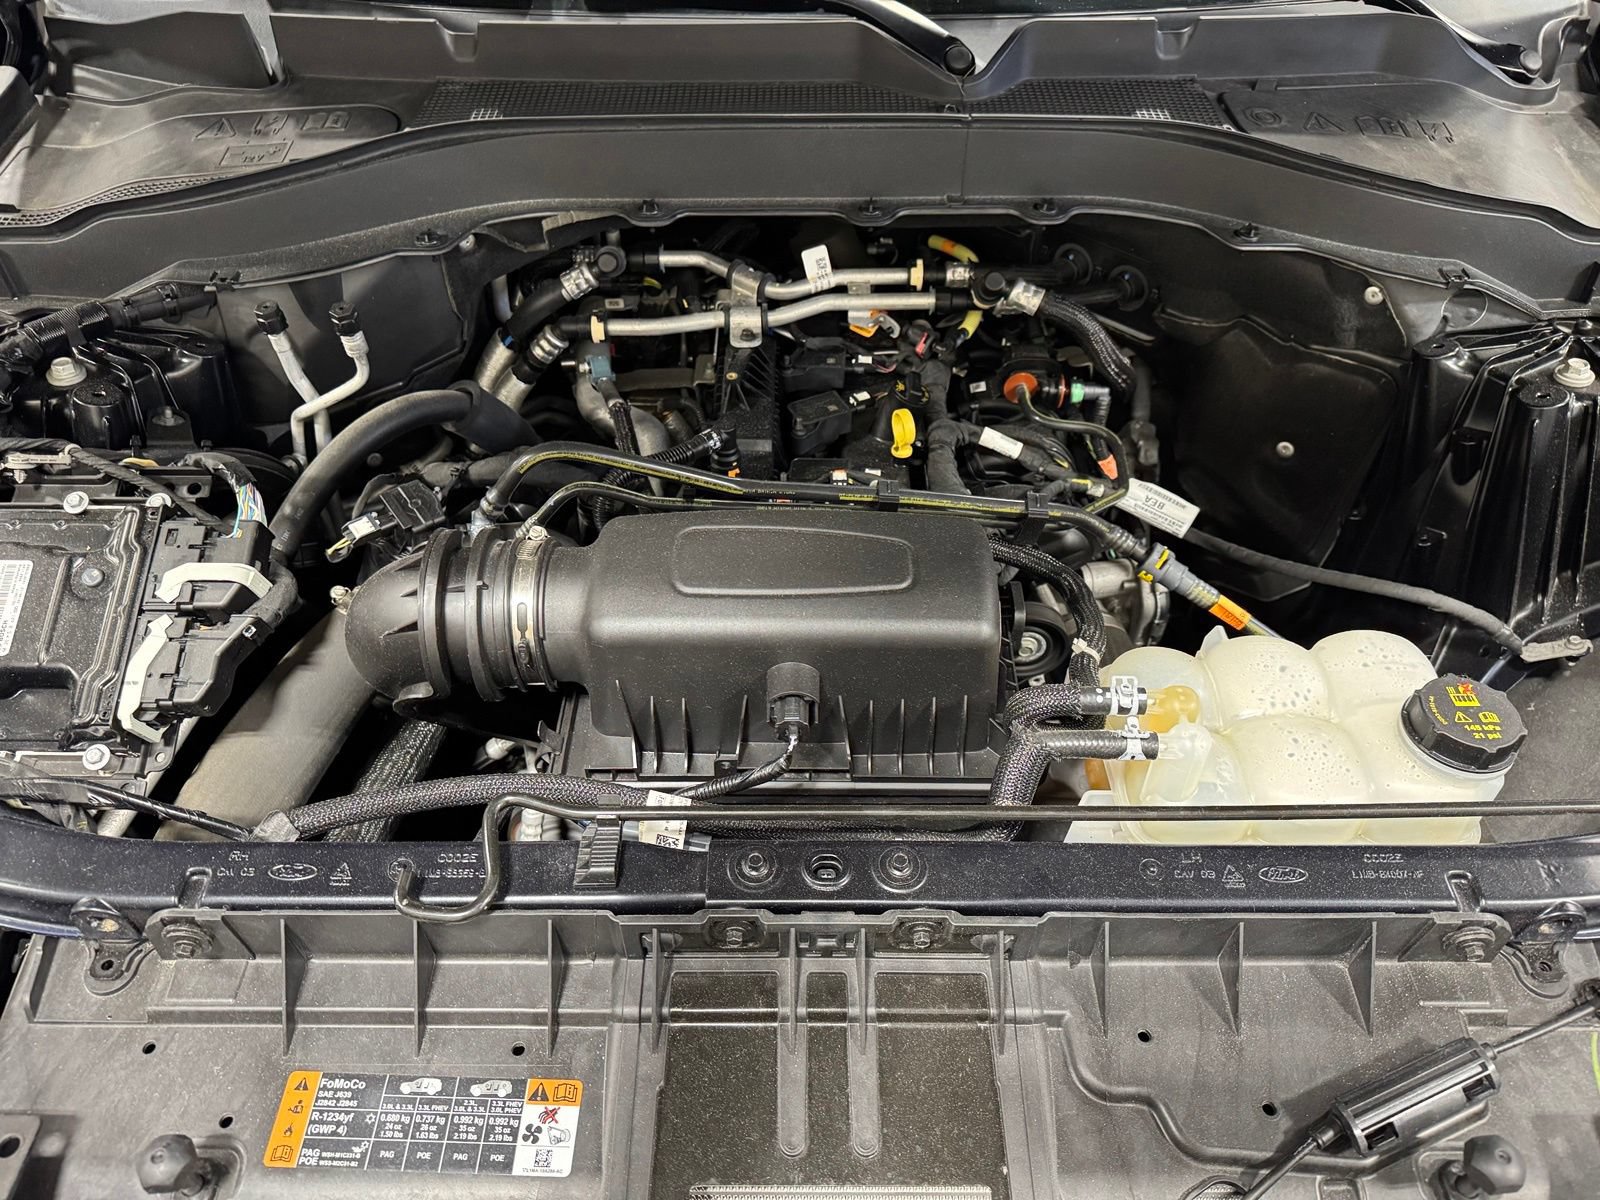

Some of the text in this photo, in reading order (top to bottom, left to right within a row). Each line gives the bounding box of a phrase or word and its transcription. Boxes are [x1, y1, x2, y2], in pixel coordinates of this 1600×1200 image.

[1144, 495, 1166, 510] BEA
[320, 1078, 366, 1090] FoMoCo
[318, 1090, 352, 1099] SAE J639
[311, 1111, 355, 1124] R-1234yf
[401, 1114, 411, 1124] kg
[415, 1114, 446, 1125] 0.737 kg
[453, 1115, 484, 1126] 0.992 kg
[488, 1117, 519, 1127] 0.992 kg
[307, 1123, 347, 1136] (GWP 4)
[459, 1124, 467, 1132] 35
[488, 1134, 502, 1142] 2.19
[301, 1148, 320, 1157] PAG
[380, 1150, 395, 1159] PAG
[416, 1151, 432, 1160] POE
[453, 1153, 468, 1161] PAG
[298, 1156, 319, 1166] POE
[490, 1154, 505, 1162] POE
